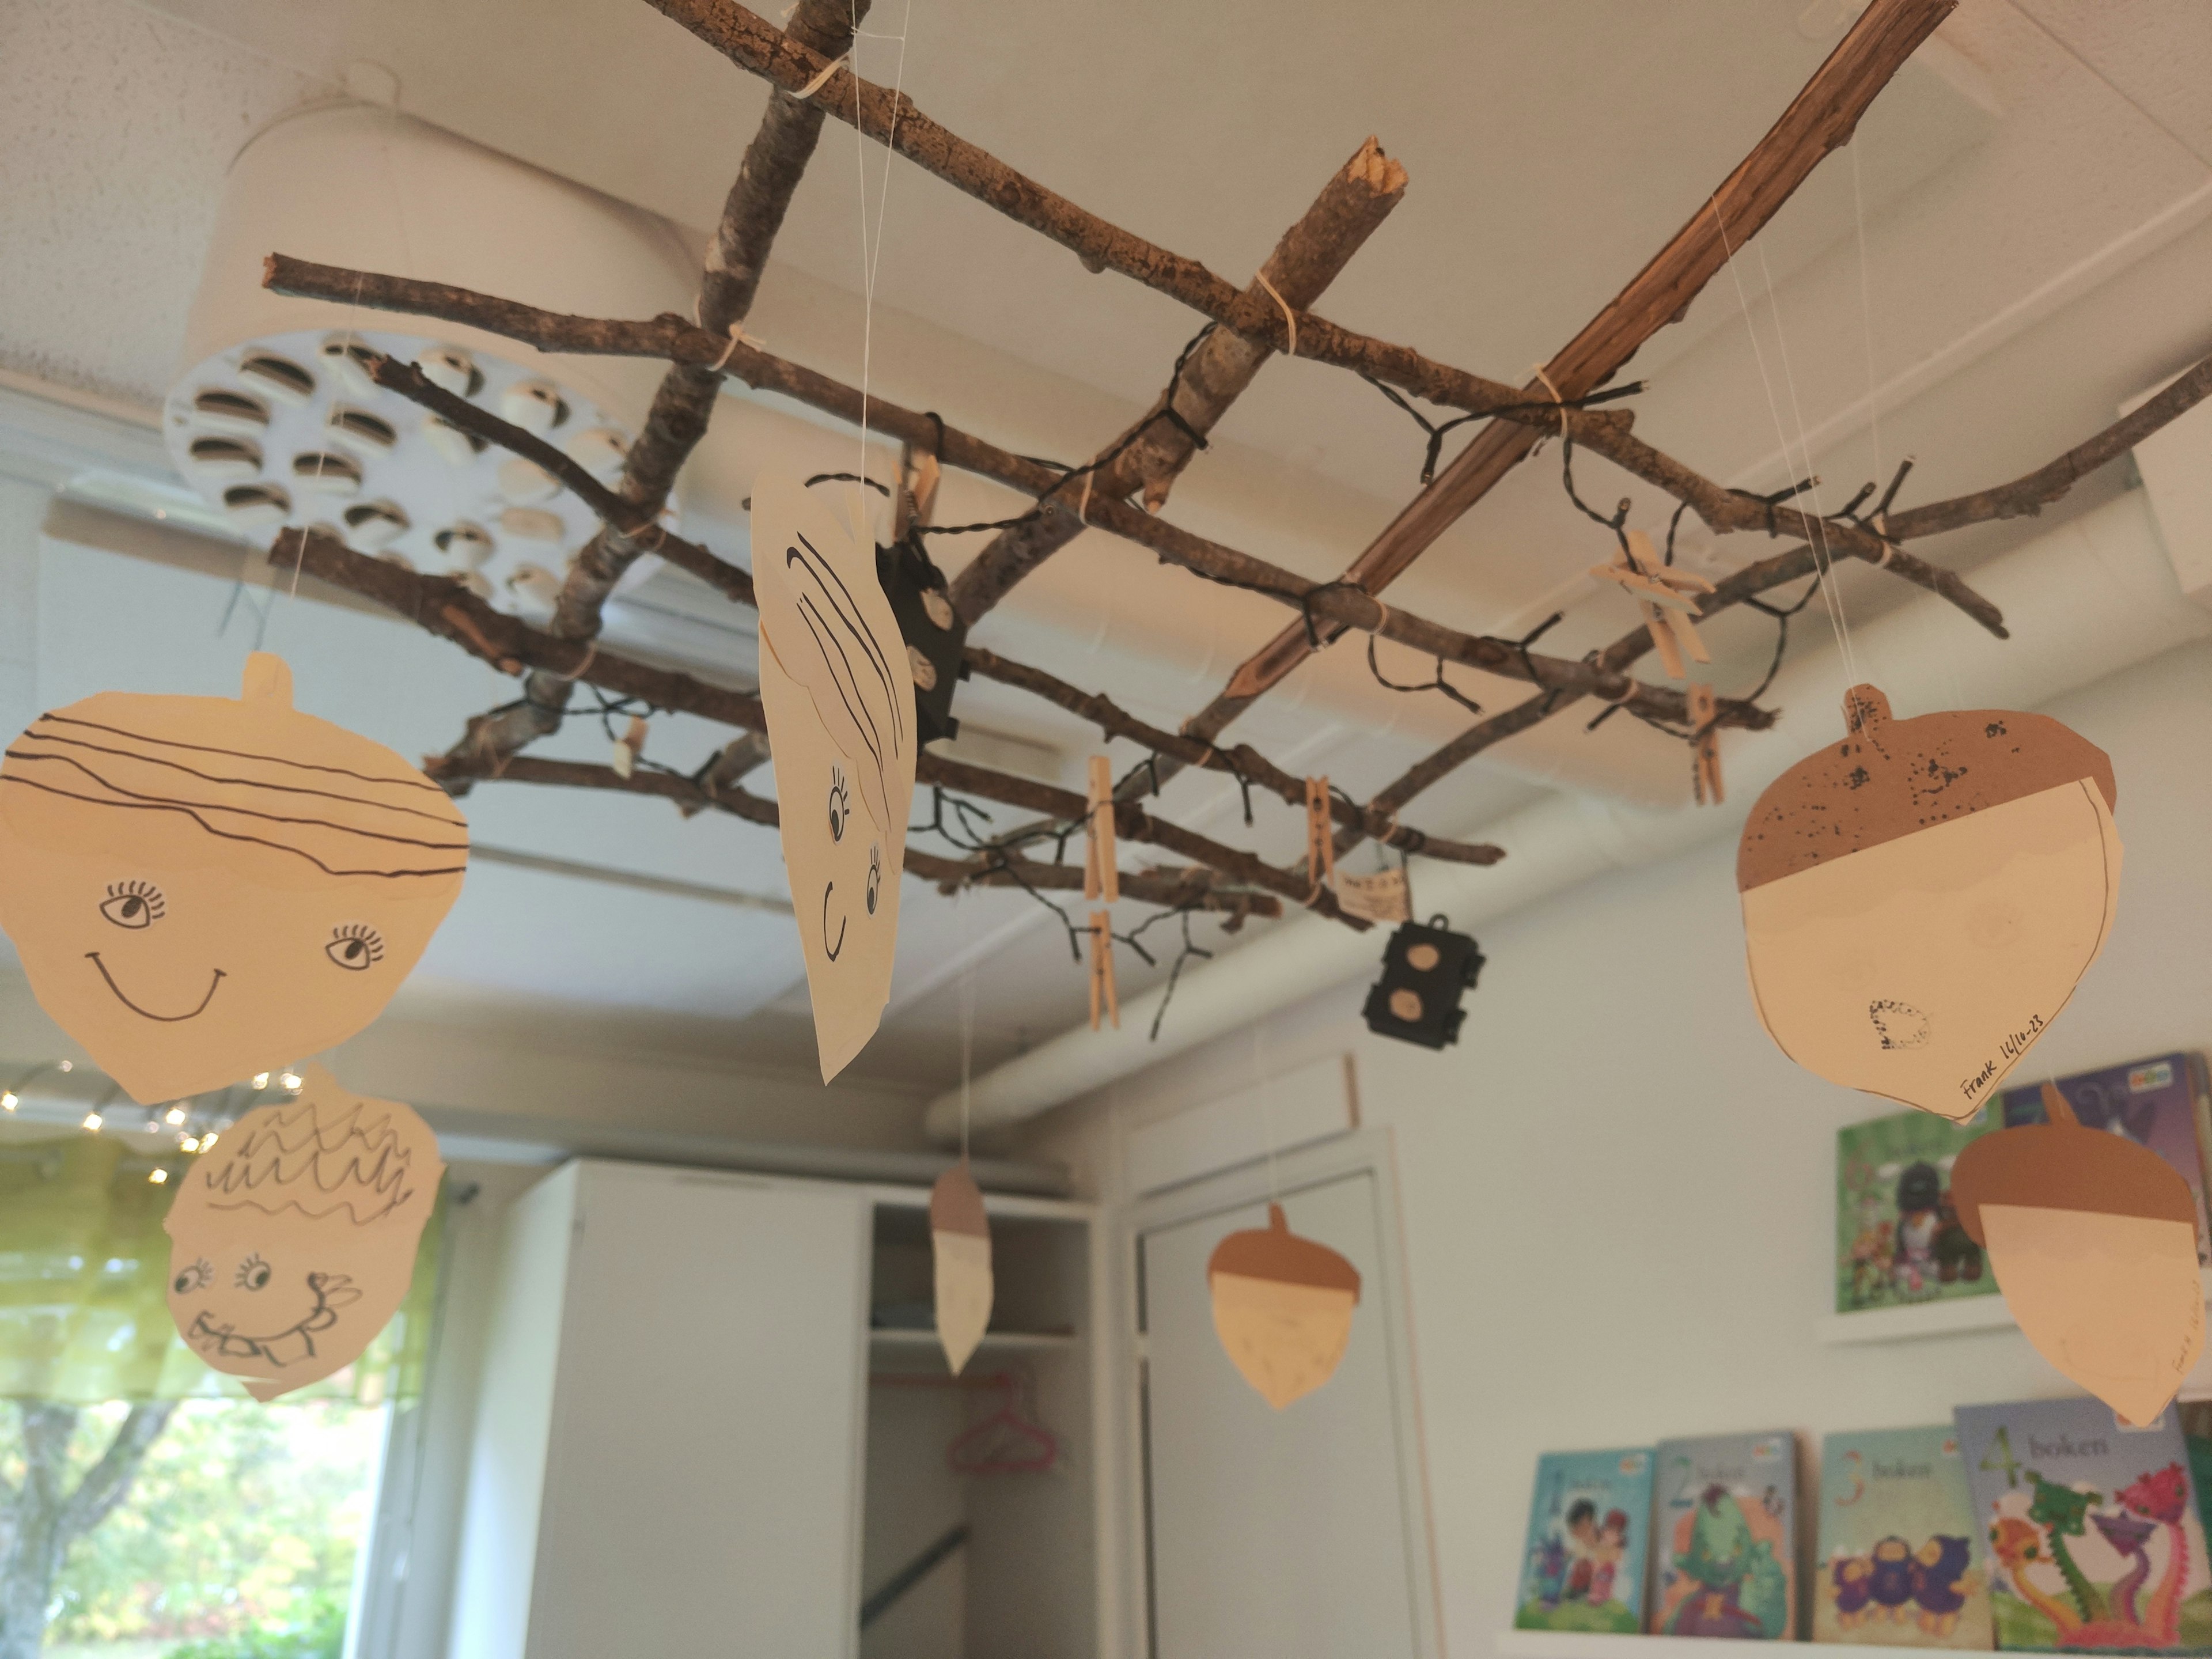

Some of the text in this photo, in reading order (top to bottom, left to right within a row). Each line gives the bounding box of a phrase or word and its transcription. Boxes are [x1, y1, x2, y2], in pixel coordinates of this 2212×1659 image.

[1960, 1014, 2044, 1100] Frank 16/10-23
[1835, 1449, 1866, 1507] 3
[1979, 1426, 2110, 1488] 4 boken
